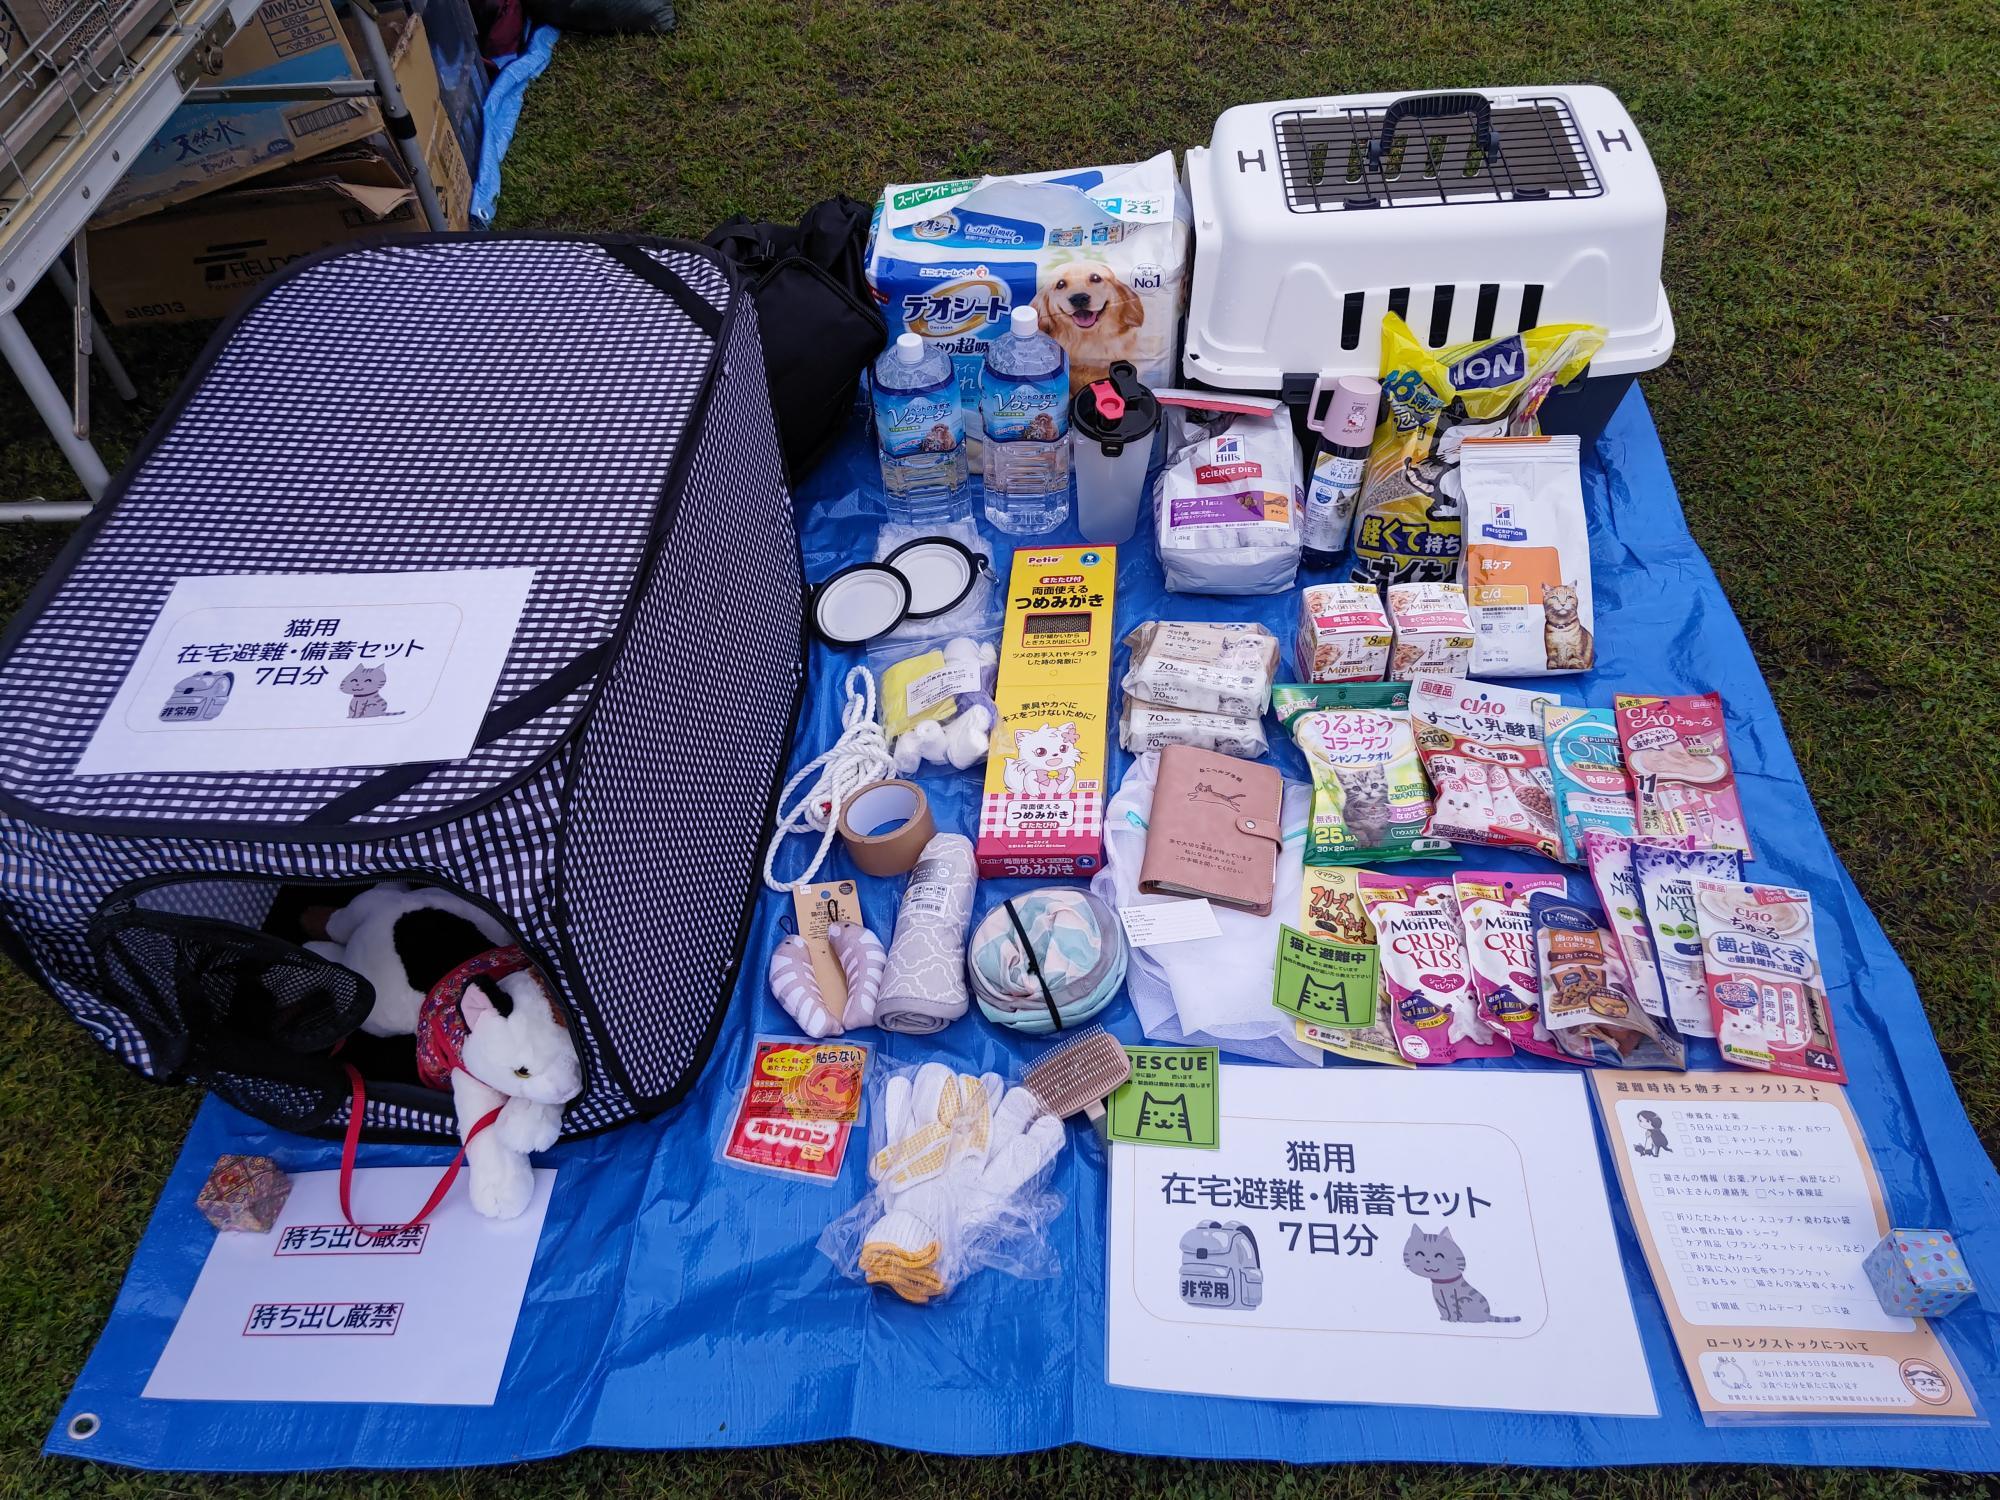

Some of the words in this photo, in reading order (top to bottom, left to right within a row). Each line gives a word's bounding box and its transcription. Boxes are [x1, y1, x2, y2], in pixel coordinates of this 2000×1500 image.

[171, 120, 245, 161] 天然水
[898, 185, 948, 206] スーパーワイド
[1134, 274, 1160, 288] No.1
[905, 297, 1009, 320] デオシート
[1454, 352, 1518, 385] ION
[911, 403, 952, 413] ペットの天然水
[994, 394, 1058, 411] Vウォーター
[888, 409, 952, 427] Vウォーター
[1216, 454, 1240, 462] Hill's
[1201, 467, 1235, 479] SCIENCE
[1361, 517, 1460, 554] 軽くて持ち
[1486, 527, 1523, 536] PRESCRIPTION
[1482, 560, 1512, 570] 尿ケア
[1032, 585, 1088, 595] 両面使える
[1482, 588, 1501, 599] c/d
[1015, 594, 1104, 609] つめみがき
[284, 618, 341, 638] 猫用
[1167, 635, 1211, 645] ウェットティッシュ
[176, 639, 425, 665] 在宅避難・備蓄セット
[254, 665, 329, 687] 7日分
[1327, 666, 1350, 674] Mon
[1421, 681, 1452, 697] 国産品
[1022, 701, 1078, 711] 家具やカベに
[1460, 699, 1505, 715] CIAO
[1619, 699, 1642, 707] 新発売
[160, 705, 198, 718] 非常用
[1002, 709, 1096, 723] キズをつけないために!
[1626, 707, 1675, 727] CIAO
[1314, 714, 1393, 735] うるおう
[1549, 712, 1571, 730] New!
[1323, 737, 1390, 750] コラーゲン
[1635, 734, 1676, 748] 液状のおやつ
[1330, 752, 1392, 762] シャンプータオル
[1468, 746, 1520, 762] まぐろ節味
[1012, 811, 1069, 819] つめみがき
[1005, 865, 1074, 875] つめみがき
[1176, 855, 1244, 873] この手帳を開いてください
[1698, 882, 1726, 893] 国産品
[1311, 886, 1354, 913] フリーズ
[1735, 907, 1772, 922] CIAO
[1391, 919, 1428, 934] Mon
[1486, 917, 1523, 931] Mon
[1484, 932, 1534, 952] CRIS
[1290, 936, 1366, 964] 猫と避難中
[1716, 936, 1805, 967] 歯と歯ぐき
[1409, 950, 1461, 969] KISS
[1499, 950, 1536, 970] KIS
[816, 1051, 861, 1063] 貼らない
[1616, 1081, 1820, 1096] 避難時持ち物チェックリスト
[752, 1121, 830, 1145] ホカロン
[805, 1147, 821, 1157] ミニ
[1286, 1139, 1355, 1174] 猫用
[1160, 1171, 1492, 1219] 在宅避難・備蓄セット
[1667, 1188, 1749, 1196] 飼い主さんの連絡先
[1768, 1189, 1824, 1197] ペット保険証
[281, 1224, 426, 1250] 持ち出し厳禁
[1278, 1221, 1380, 1257] 7日分
[1690, 1251, 1762, 1261] 折りたたみケージ
[1702, 1277, 1737, 1286] おもちゃ
[1182, 1279, 1229, 1300] 非常用
[1711, 1302, 1740, 1310] 新聞紙
[1759, 1304, 1803, 1312] ガムテープ
[250, 1303, 398, 1330] 持ち出し厳禁
[1706, 1338, 1870, 1351] ローリングストックについて
